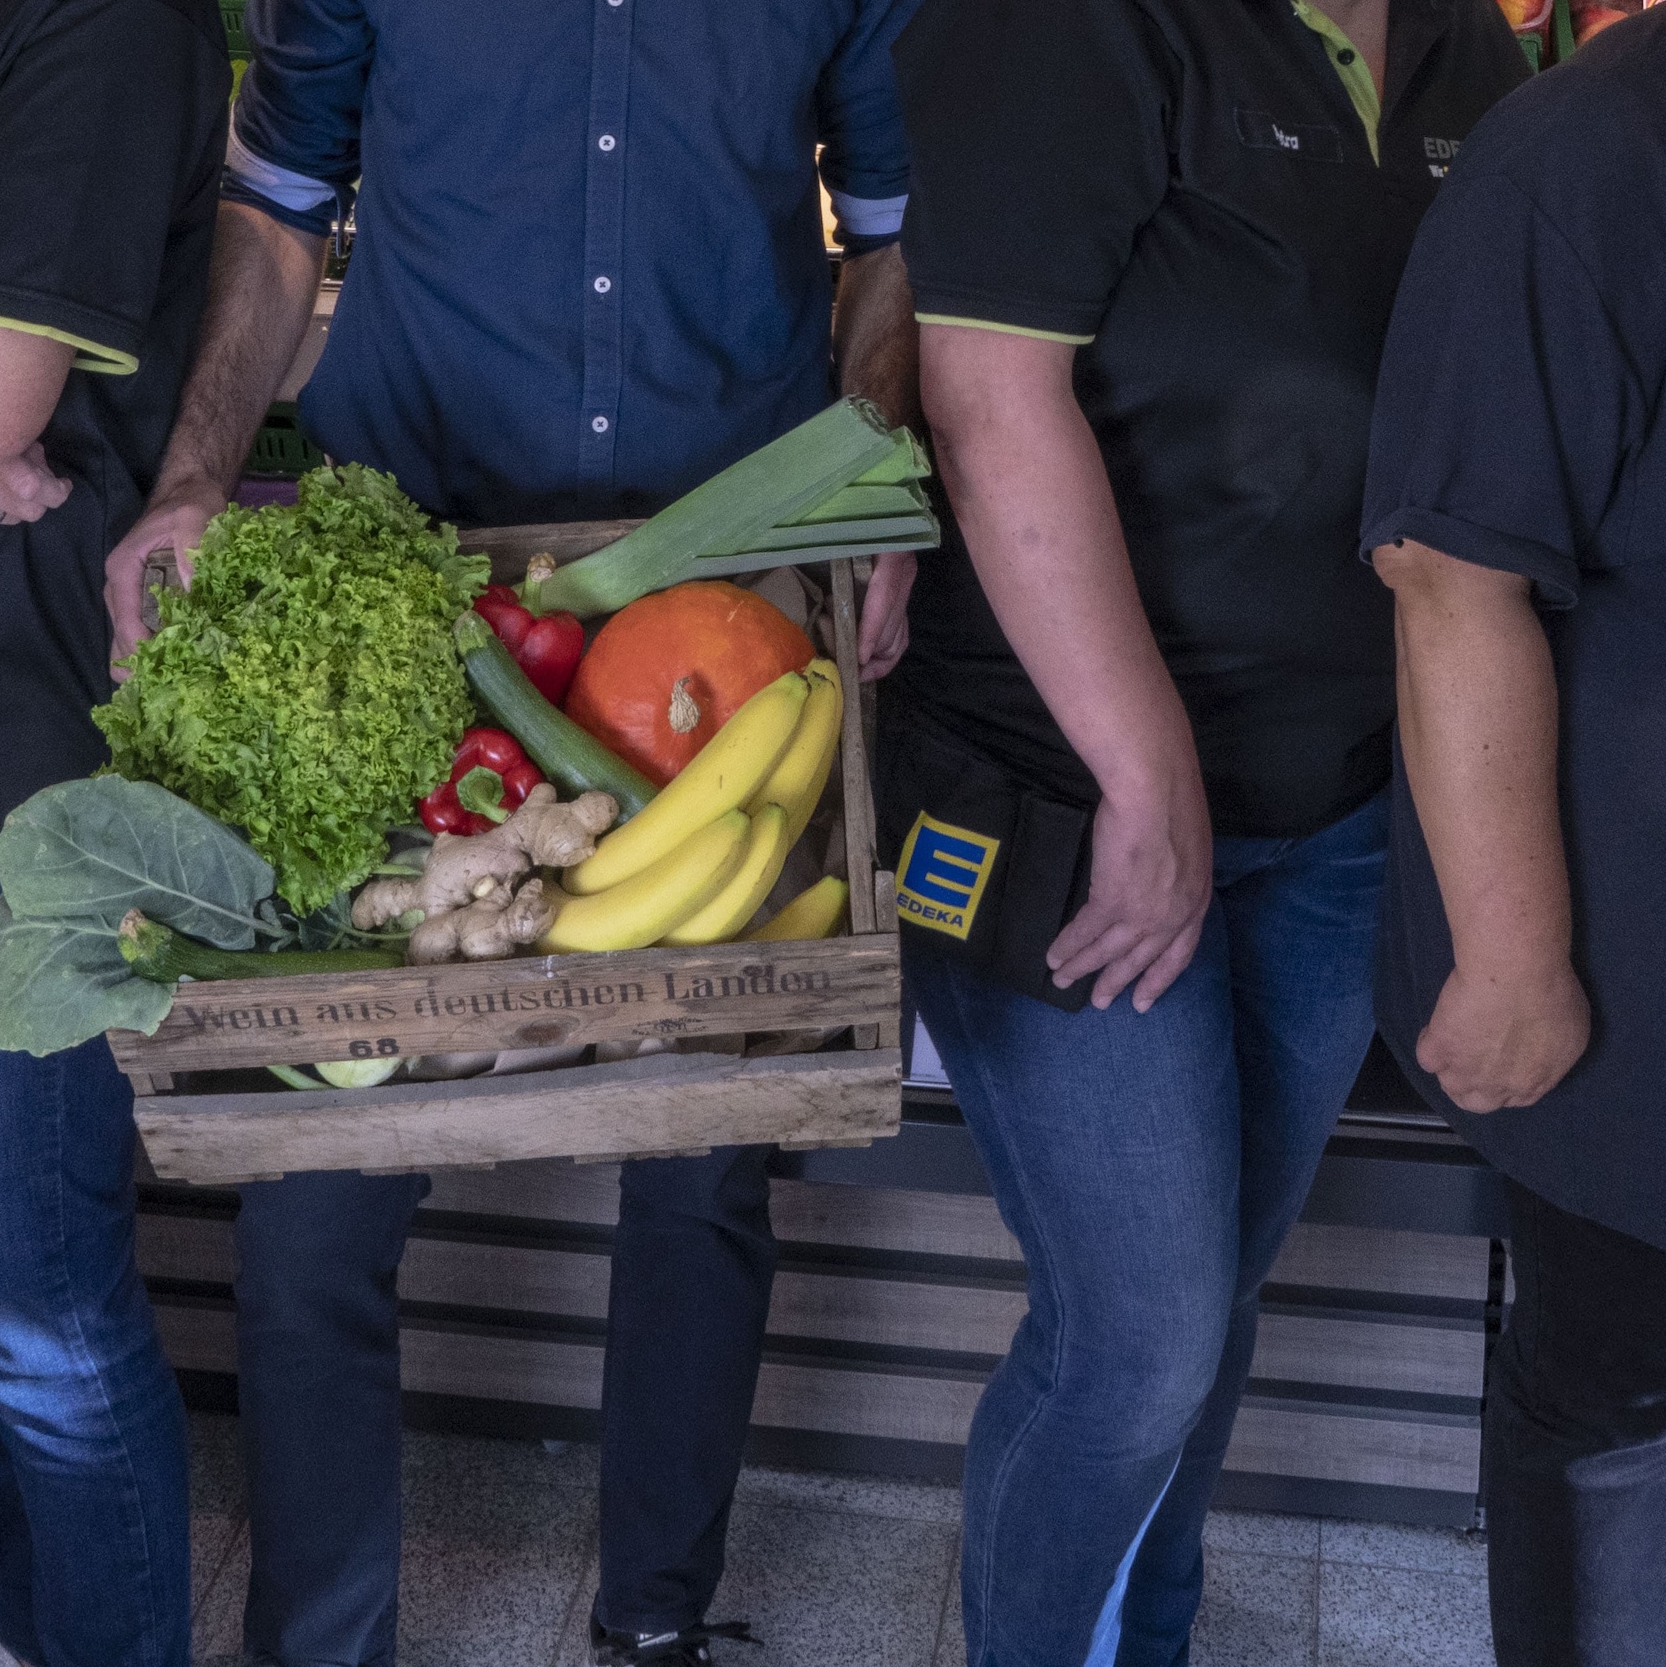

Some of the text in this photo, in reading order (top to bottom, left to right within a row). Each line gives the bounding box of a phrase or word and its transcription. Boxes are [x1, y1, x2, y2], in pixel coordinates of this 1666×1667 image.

[903, 825, 986, 909] E
[897, 893, 965, 929] EDEKA
[185, 1003, 300, 1032] Wein
[316, 999, 397, 1023] aus
[414, 977, 645, 1017] deutschen
[348, 1037, 400, 1058] 68
